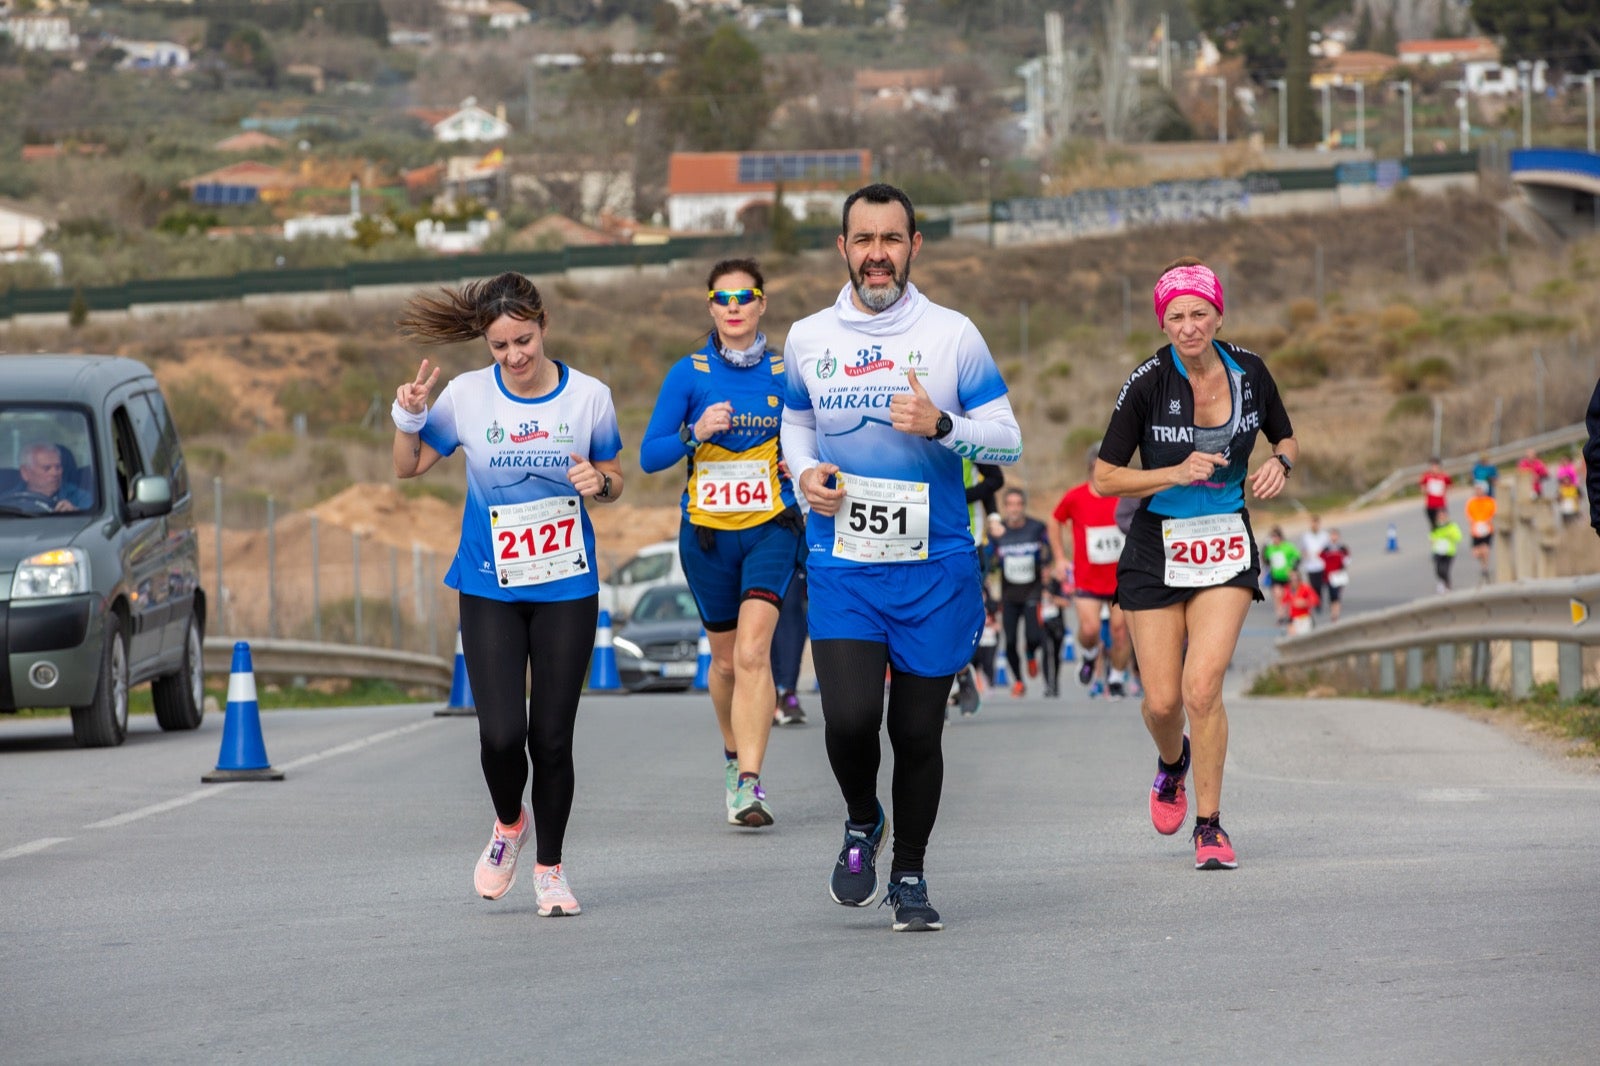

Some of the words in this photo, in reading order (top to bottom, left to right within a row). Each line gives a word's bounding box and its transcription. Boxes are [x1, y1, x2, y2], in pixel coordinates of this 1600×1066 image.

[855, 345, 882, 368] 35
[518, 420, 540, 437] 35
[489, 456, 570, 468] MARACENA
[702, 481, 768, 505] 2164
[849, 502, 907, 535] 551
[498, 518, 575, 560] 2127
[1171, 536, 1245, 565] 2035
